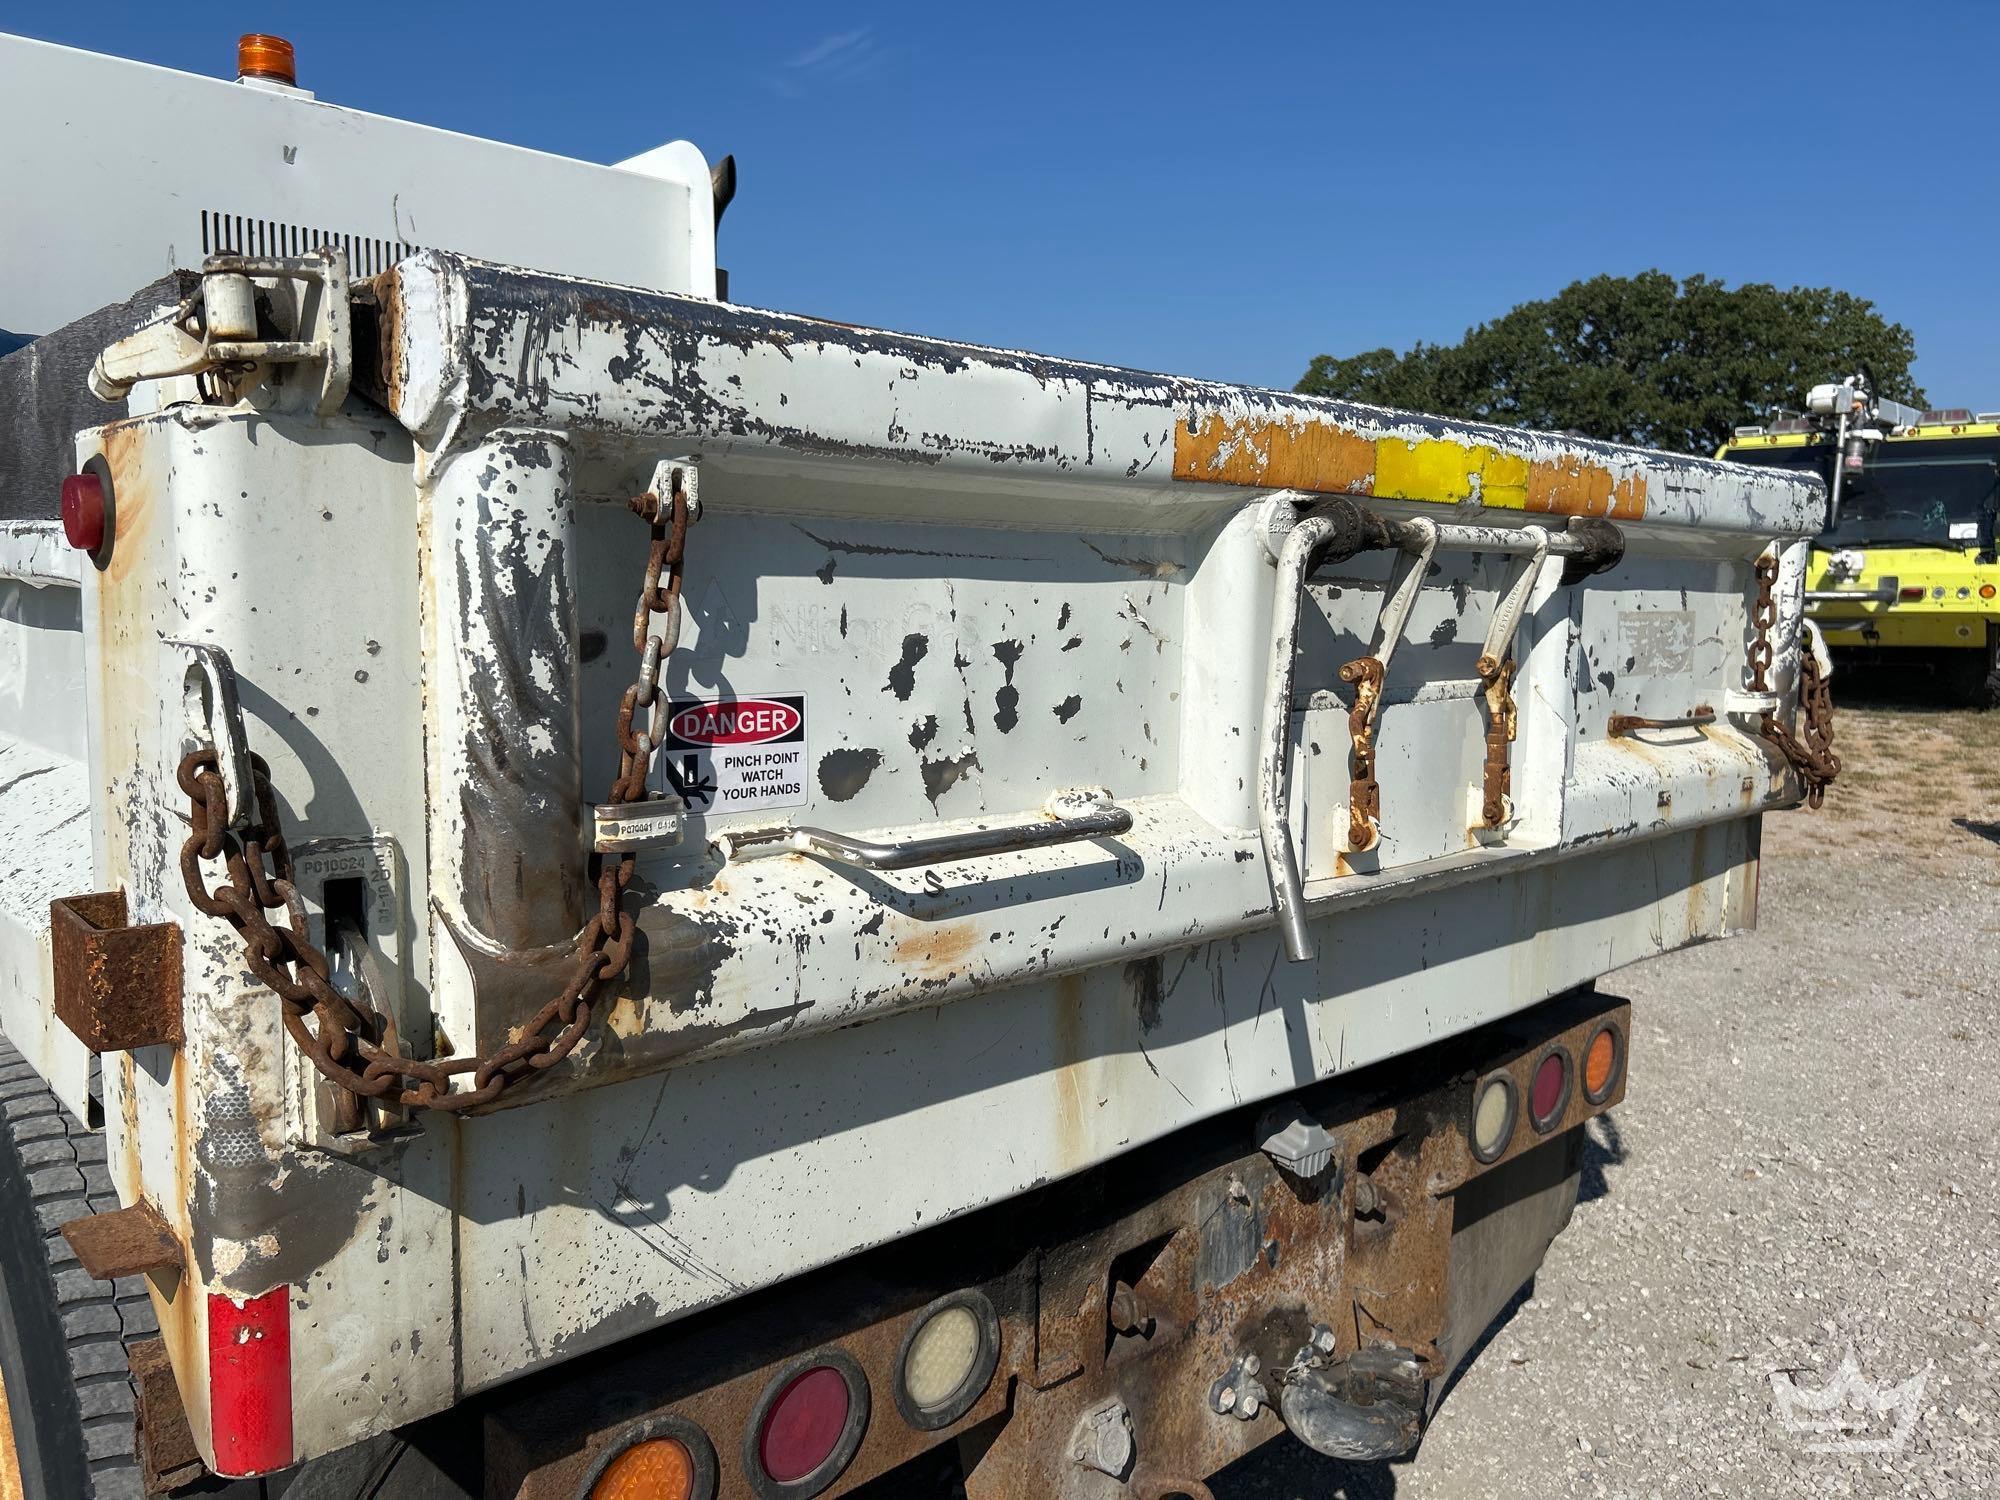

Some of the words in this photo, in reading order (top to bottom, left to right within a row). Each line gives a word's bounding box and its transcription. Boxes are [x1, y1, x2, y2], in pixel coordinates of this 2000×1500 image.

[683, 709, 788, 737] DANGER
[724, 754, 762, 769] PINCH
[764, 752, 800, 766] POINT
[741, 769, 784, 783] WATCH
[722, 787, 758, 801] YOUR
[760, 783, 801, 797] HANDS
